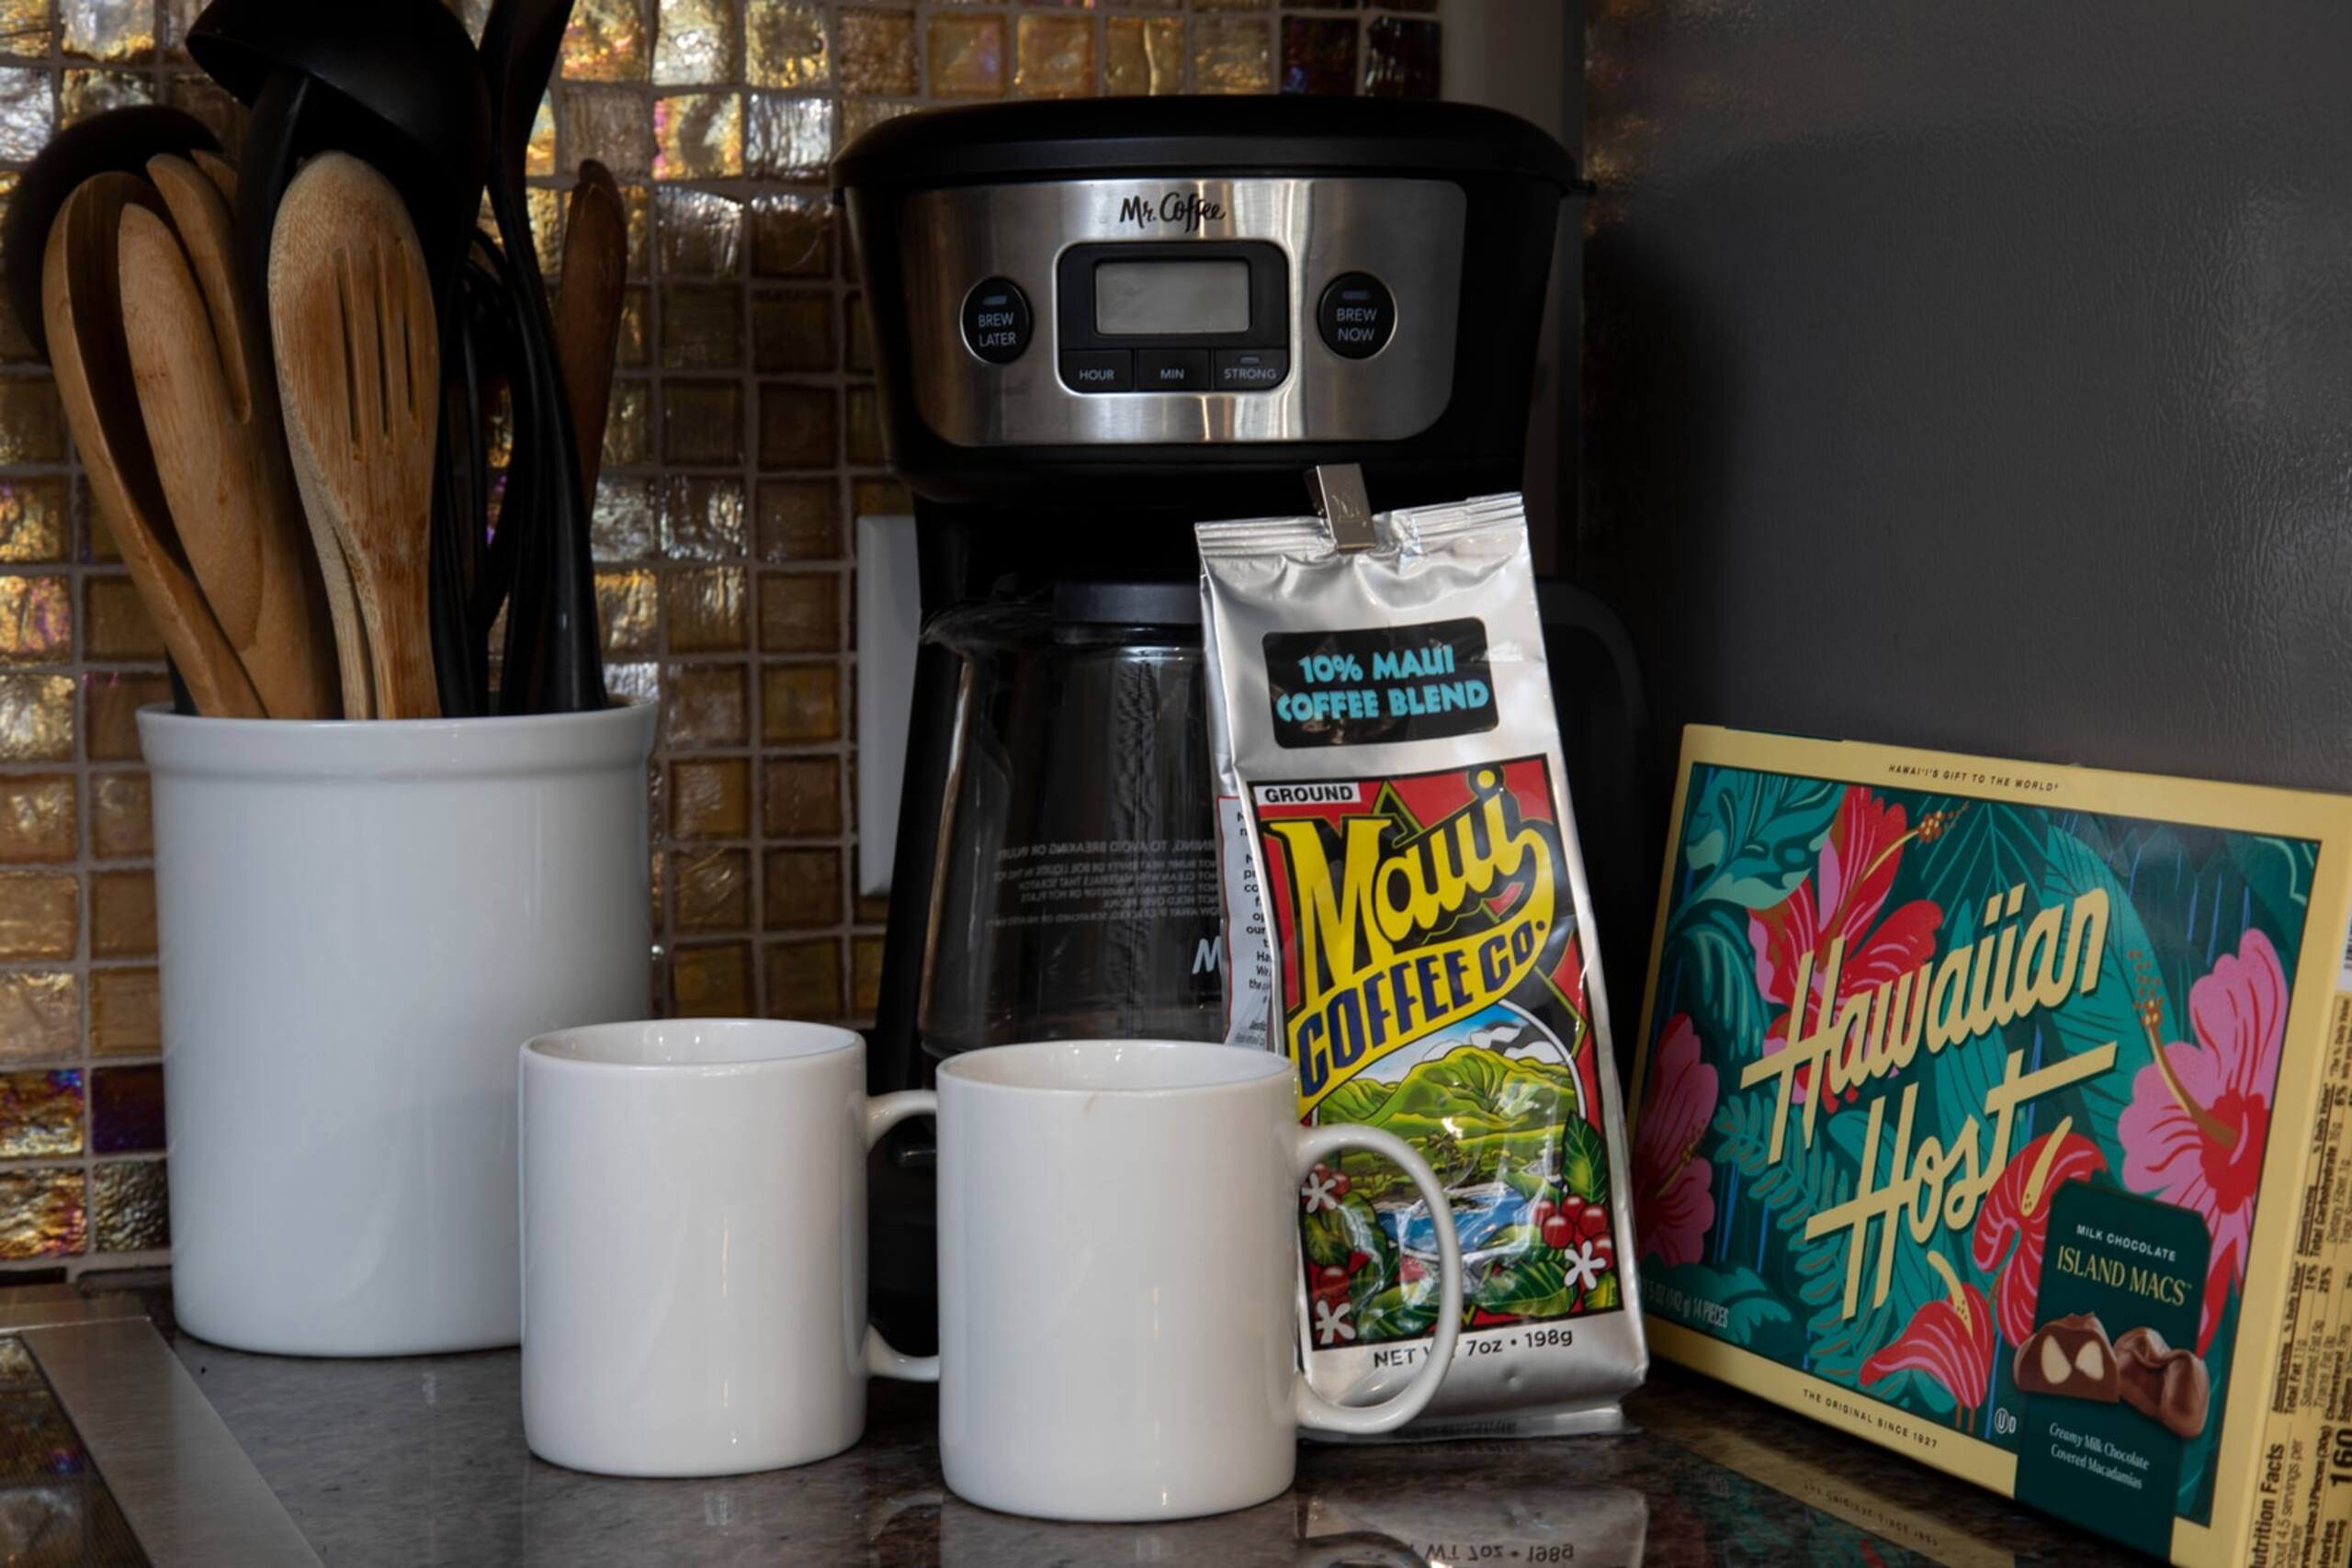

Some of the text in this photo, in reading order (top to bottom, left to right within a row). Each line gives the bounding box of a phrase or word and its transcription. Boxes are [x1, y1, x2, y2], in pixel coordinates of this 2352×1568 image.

[1119, 191, 1227, 233] Mr. Coffee
[978, 310, 1014, 329] BREW
[1336, 307, 1378, 323] BREW
[1337, 326, 1375, 343] NOW
[978, 330, 1017, 348] LATER
[1079, 368, 1114, 381] HOUR
[1159, 368, 1185, 381] MIN
[1223, 367, 1277, 381] STRONG
[1298, 644, 1456, 683] 10% MAUI
[1276, 680, 1489, 723] COFFEE BLEND
[1264, 784, 1353, 804] GROUND
[1943, 770, 1968, 781] GIFT
[1972, 773, 1985, 784] TO
[1990, 775, 2010, 787] THE
[1270, 769, 1551, 999] Maui
[1296, 949, 1474, 1098] COFFEE
[1739, 882, 2109, 1167] Hawaiian
[1804, 1040, 2118, 1320] Host
[2314, 1145, 2337, 1224] Carbohydrate
[2076, 1224, 2177, 1263] MILK CHOCOLATE
[2309, 1228, 2324, 1257] Total
[2057, 1245, 2125, 1288] ISLAND
[1373, 1348, 1415, 1369] NET
[1466, 1339, 1503, 1358] 7oz
[1524, 1328, 1573, 1349] 198g
[2290, 1362, 2301, 1382] Fat
[1804, 1388, 1939, 1449] THE ORIGINAL SINCE 1927
[2284, 1384, 2298, 1414] Total
[2049, 1422, 2150, 1471] Creamy Milk Chocolate
[2051, 1442, 2143, 1491] Covered Macadamias
[2290, 1438, 2304, 1461] per
[2328, 1427, 2352, 1489] 160
[2260, 1441, 2284, 1494] Facts
[2280, 1462, 2301, 1517] servings
[2276, 1518, 2290, 1540] 4.5
[2300, 1535, 2316, 1568] rving
[2310, 1460, 2324, 1499] Pieces
